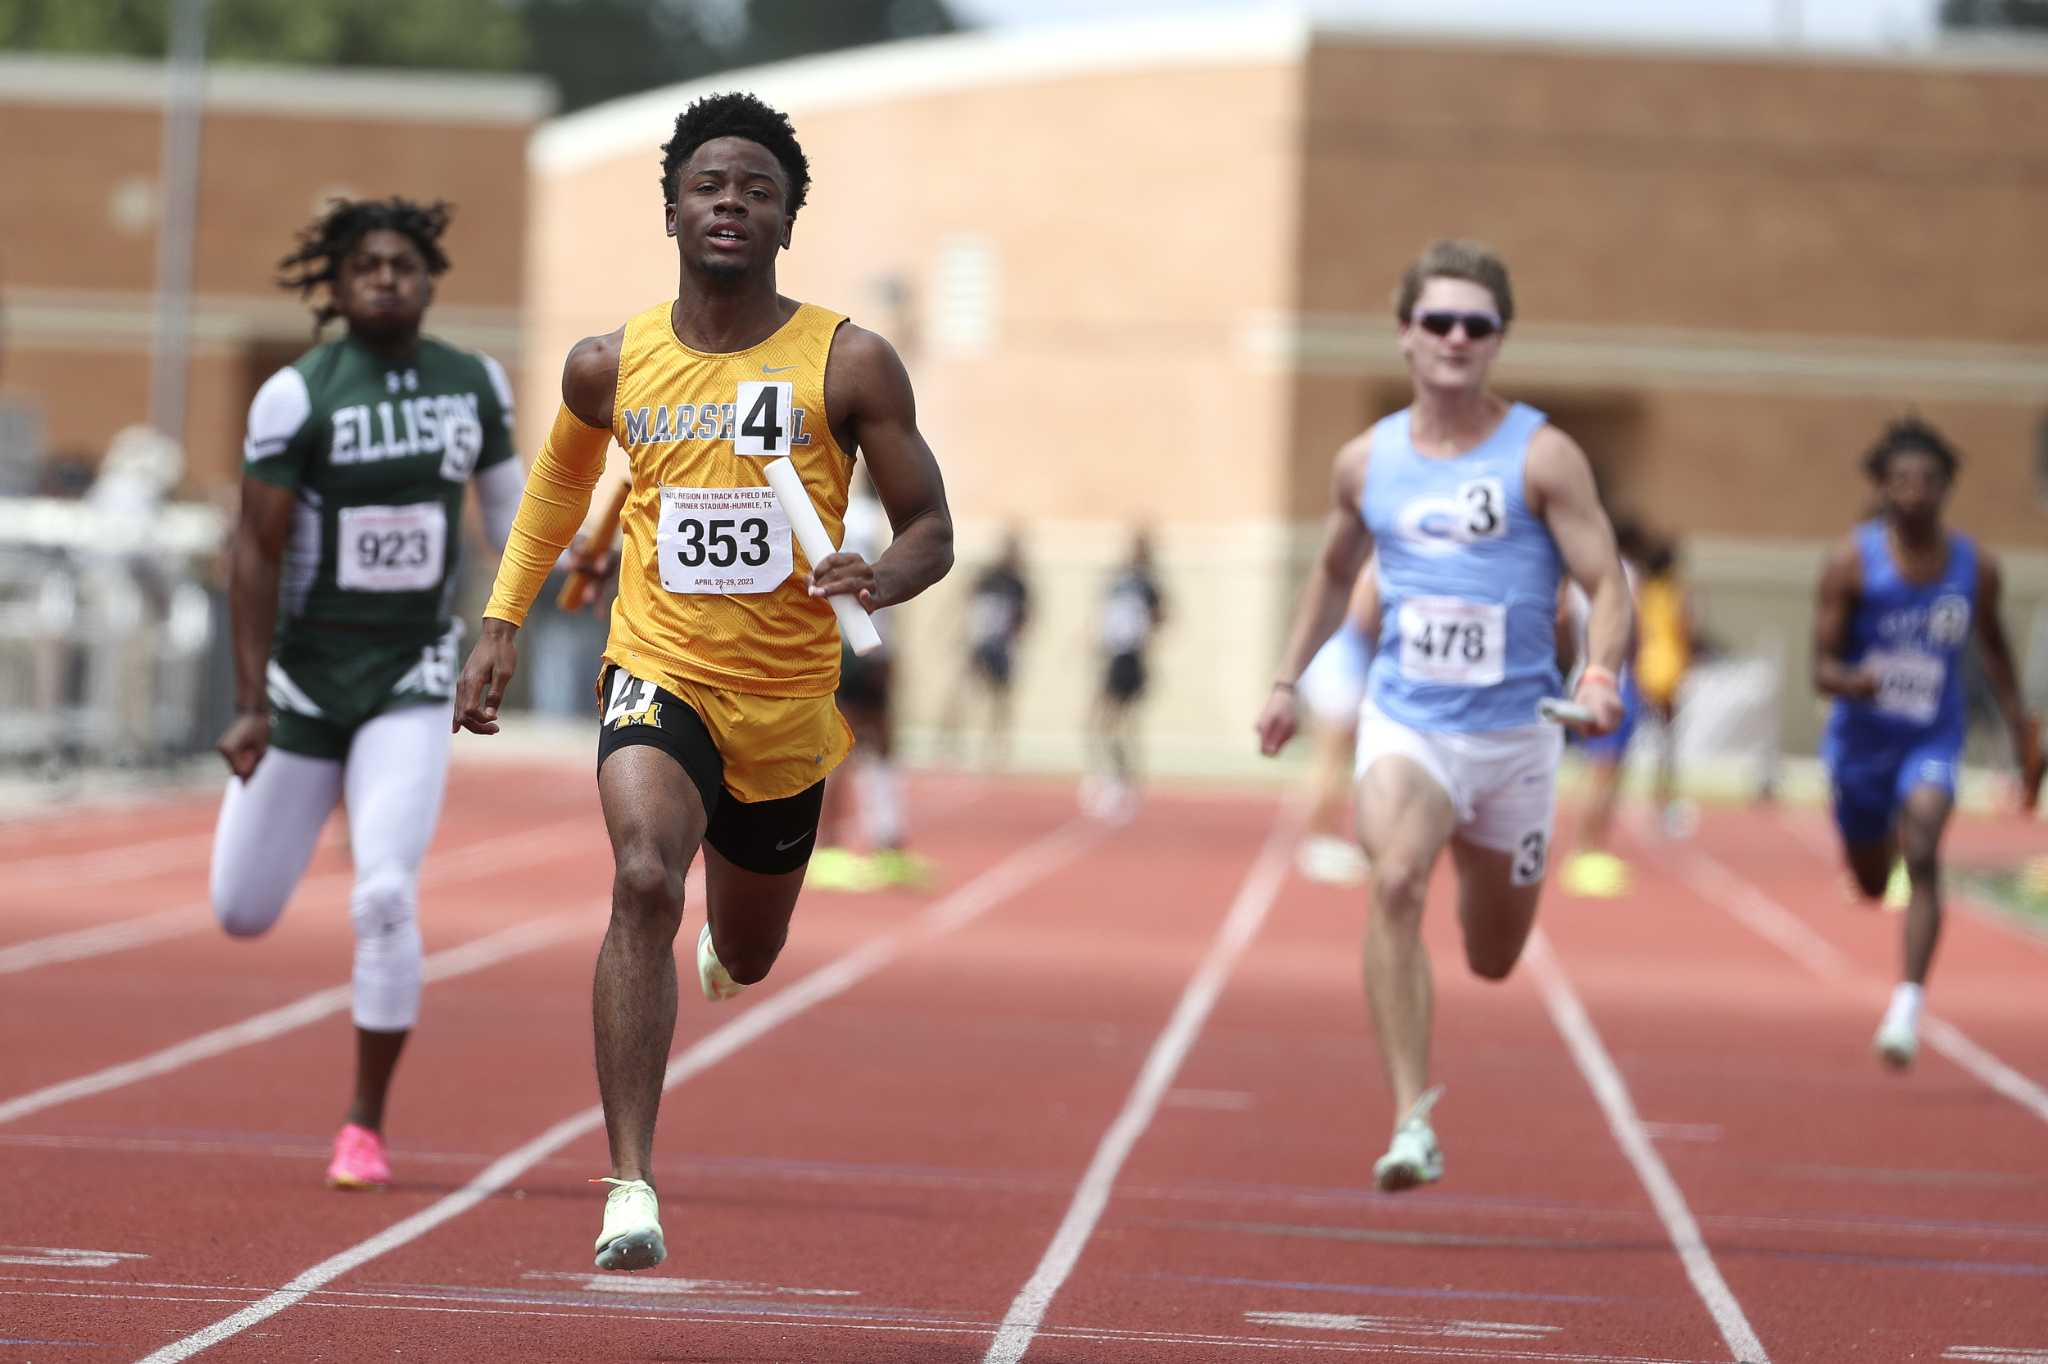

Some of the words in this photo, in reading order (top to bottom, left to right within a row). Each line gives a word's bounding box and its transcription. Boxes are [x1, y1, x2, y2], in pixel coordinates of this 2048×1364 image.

[624, 403, 812, 446] MARSHL
[741, 386, 782, 450] 4
[678, 492, 701, 500] REGION
[710, 492, 733, 500] TRACK
[741, 491, 760, 499] FIELD
[761, 491, 776, 499] MEE
[763, 501, 773, 509] TX
[1466, 485, 1499, 535] 3
[356, 530, 430, 570] 923
[677, 517, 771, 567] 353
[737, 577, 754, 586] 2023
[1412, 622, 1487, 664] 478
[612, 674, 646, 711] 4
[1520, 830, 1545, 881] 3
